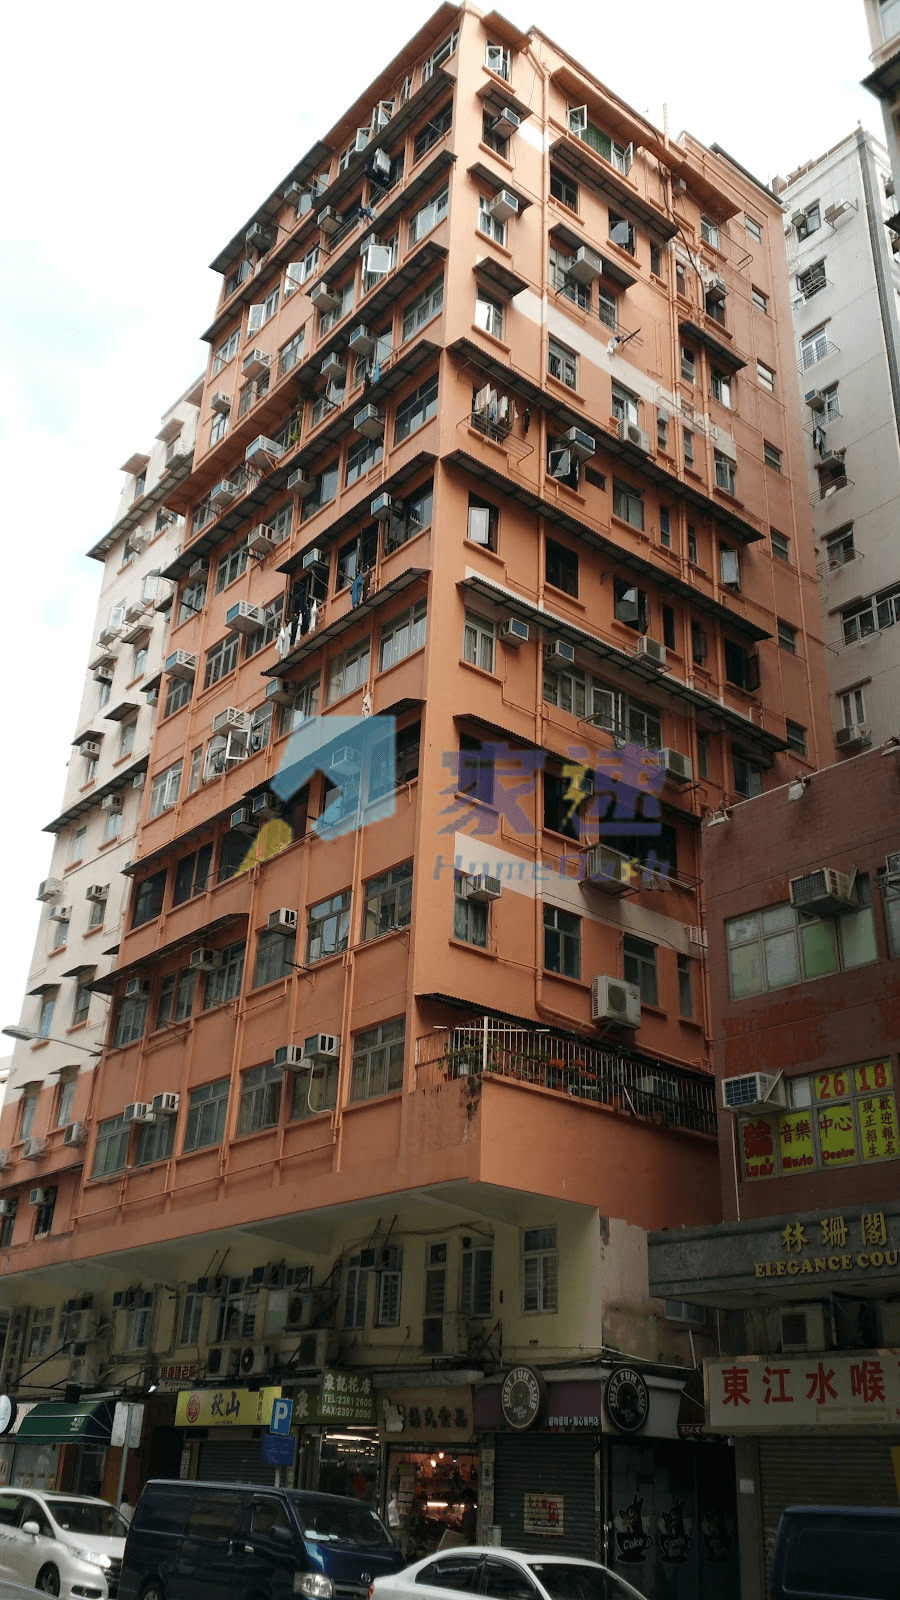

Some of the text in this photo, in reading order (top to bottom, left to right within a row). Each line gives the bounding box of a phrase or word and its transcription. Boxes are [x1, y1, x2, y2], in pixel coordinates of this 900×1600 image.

[863, 1101, 879, 1158] 現正招生
[783, 1154, 814, 1168] Music
[754, 1254, 853, 1278] ELEGANCE
[722, 1360, 900, 1406] 東江水喉
[274, 1401, 289, 1430] P
[623, 1537, 643, 1550] Cake
